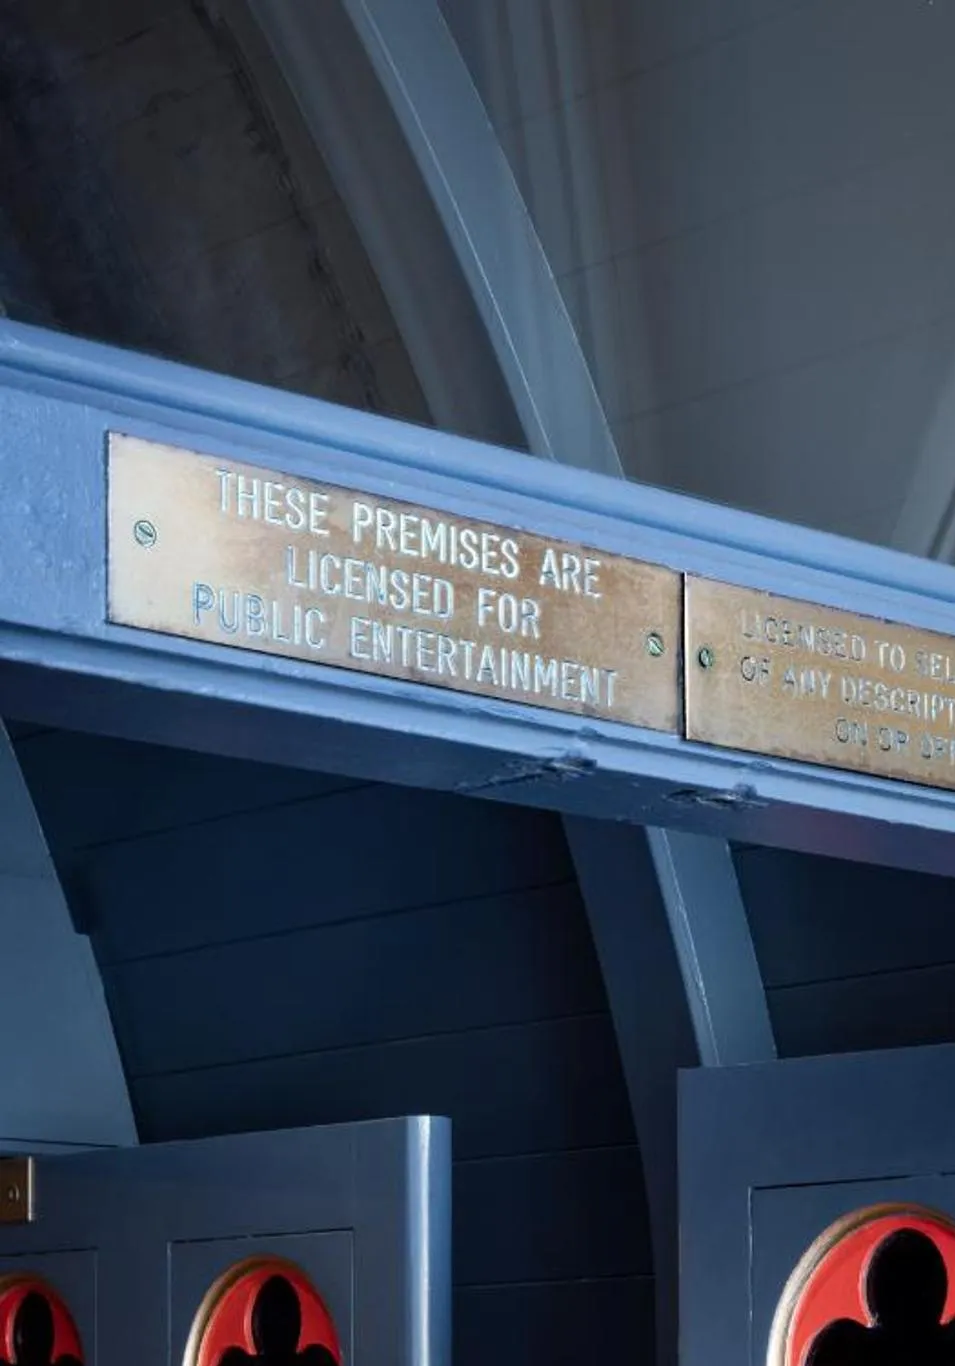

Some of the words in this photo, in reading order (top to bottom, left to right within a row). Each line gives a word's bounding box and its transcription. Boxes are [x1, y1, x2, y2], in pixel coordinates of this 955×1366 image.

[215, 469, 329, 537] THESE
[353, 502, 520, 578] PREMISES
[539, 548, 601, 599] ARE
[286, 546, 454, 619] LICENSED
[477, 589, 540, 638] FOR
[192, 582, 327, 650] PUBLIC
[350, 616, 617, 707] ENTERTAINMENT
[739, 656, 771, 685] OF
[782, 666, 831, 700] ANY
[740, 611, 867, 662] LICENSED
[874, 641, 906, 672] TO
[835, 718, 867, 747] ON
